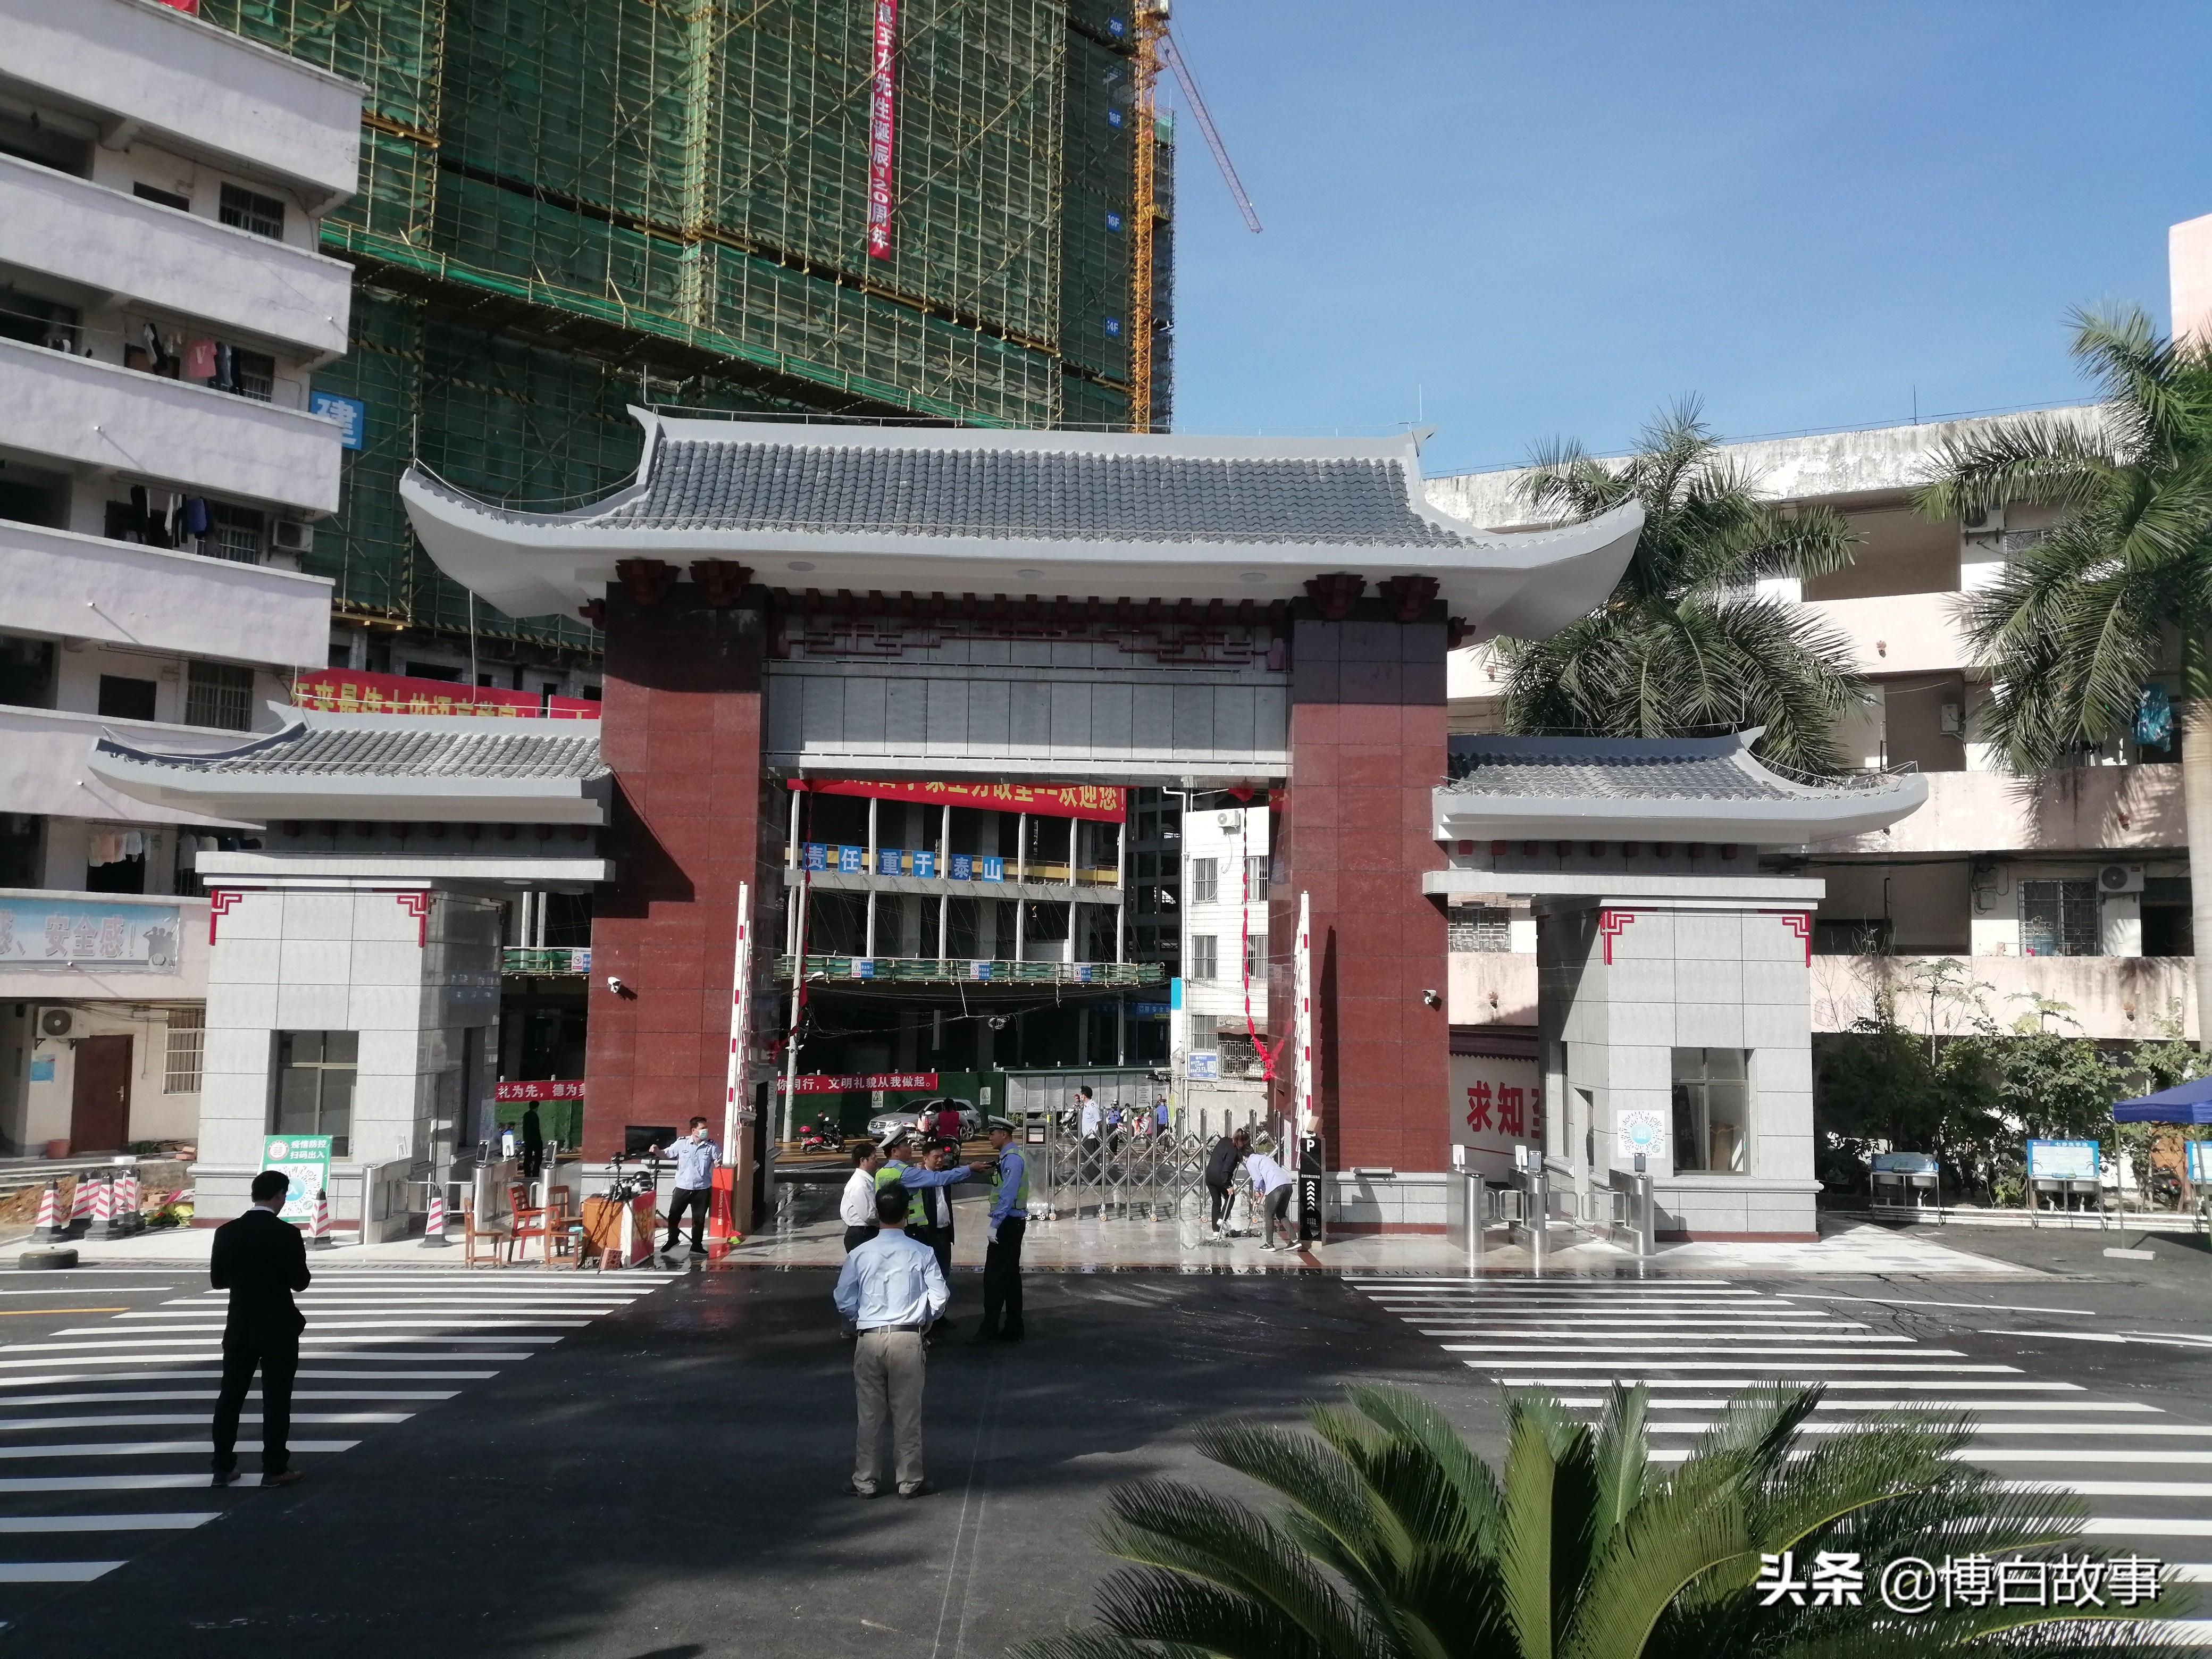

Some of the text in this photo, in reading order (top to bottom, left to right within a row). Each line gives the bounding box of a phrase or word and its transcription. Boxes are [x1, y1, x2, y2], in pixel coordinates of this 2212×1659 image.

[1110, 20, 1122, 32] 20F
[1109, 112, 1121, 124] 18F
[1108, 215, 1119, 228] 16F
[805, 845, 1001, 881] 责任重于泰山
[1306, 1139, 1315, 1152] P
[290, 1151, 325, 1159] 扫码出入
